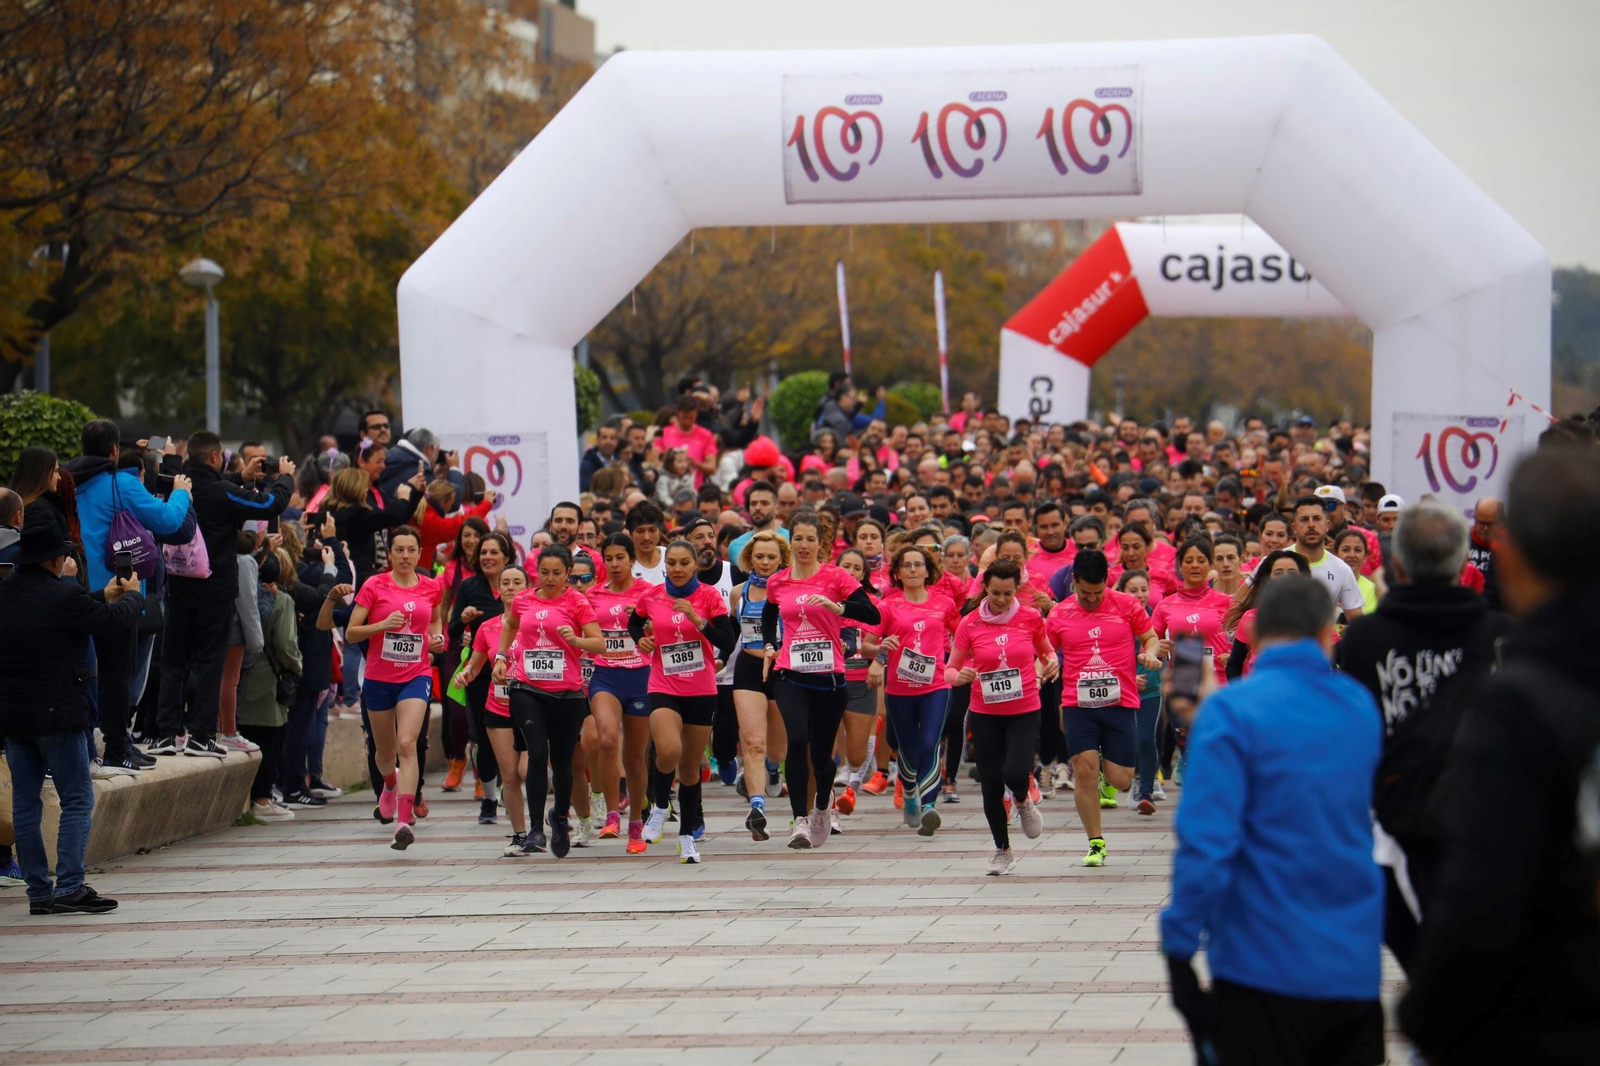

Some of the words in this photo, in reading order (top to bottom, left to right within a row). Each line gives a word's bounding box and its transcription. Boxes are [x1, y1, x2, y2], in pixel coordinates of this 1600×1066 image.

[787, 105, 883, 182] 100
[911, 102, 1007, 179] 100
[1035, 98, 1133, 175] 100
[1048, 280, 1112, 345] cajasur
[1029, 375, 1054, 424] ca
[1416, 426, 1499, 493] 100
[392, 641, 415, 653] 1033
[605, 639, 625, 649] 1704
[670, 650, 694, 664] 1389
[800, 651, 823, 663] 1020
[531, 659, 554, 670] 1054
[908, 660, 926, 674] 839
[989, 679, 1012, 692] 1419
[1089, 687, 1108, 699] 640
